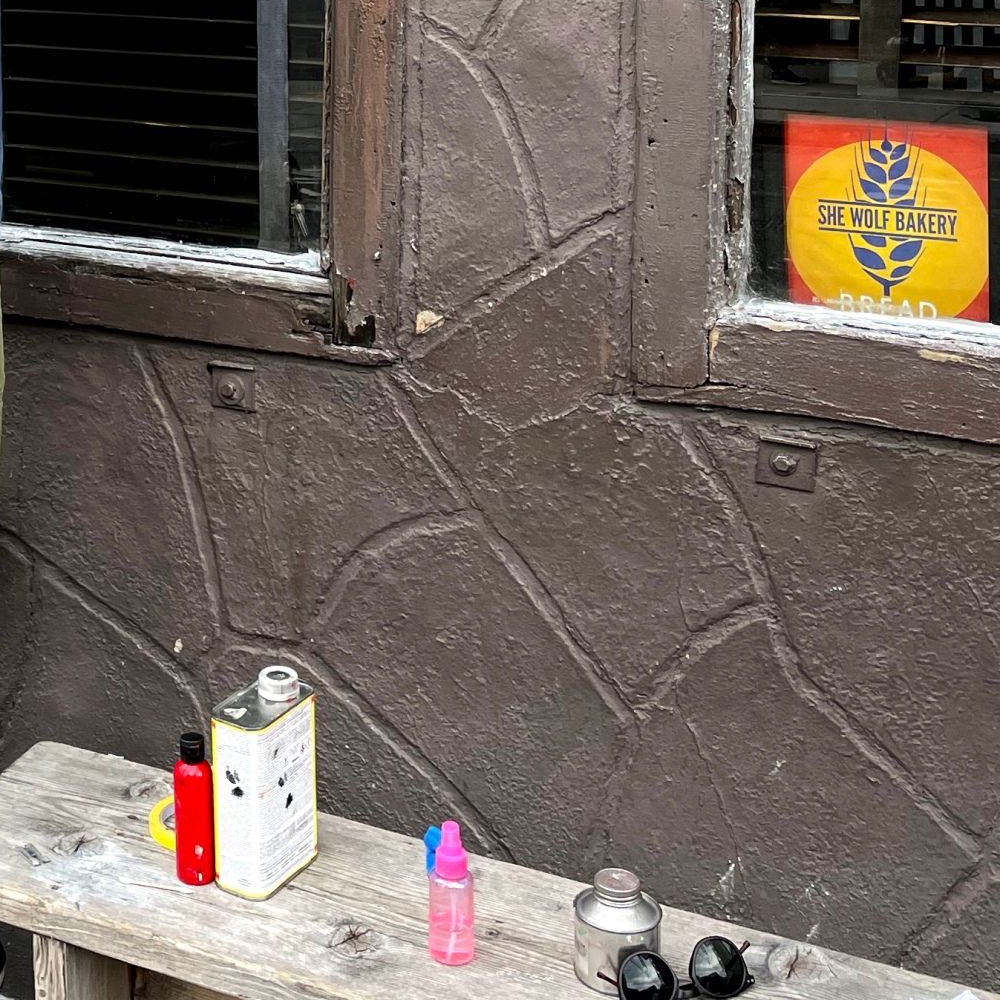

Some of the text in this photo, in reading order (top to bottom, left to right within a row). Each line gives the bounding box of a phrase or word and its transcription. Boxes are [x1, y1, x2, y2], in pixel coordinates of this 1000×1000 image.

[818, 204, 957, 236] SHE WOLF BAKERY
[840, 293, 938, 319] BREAD
